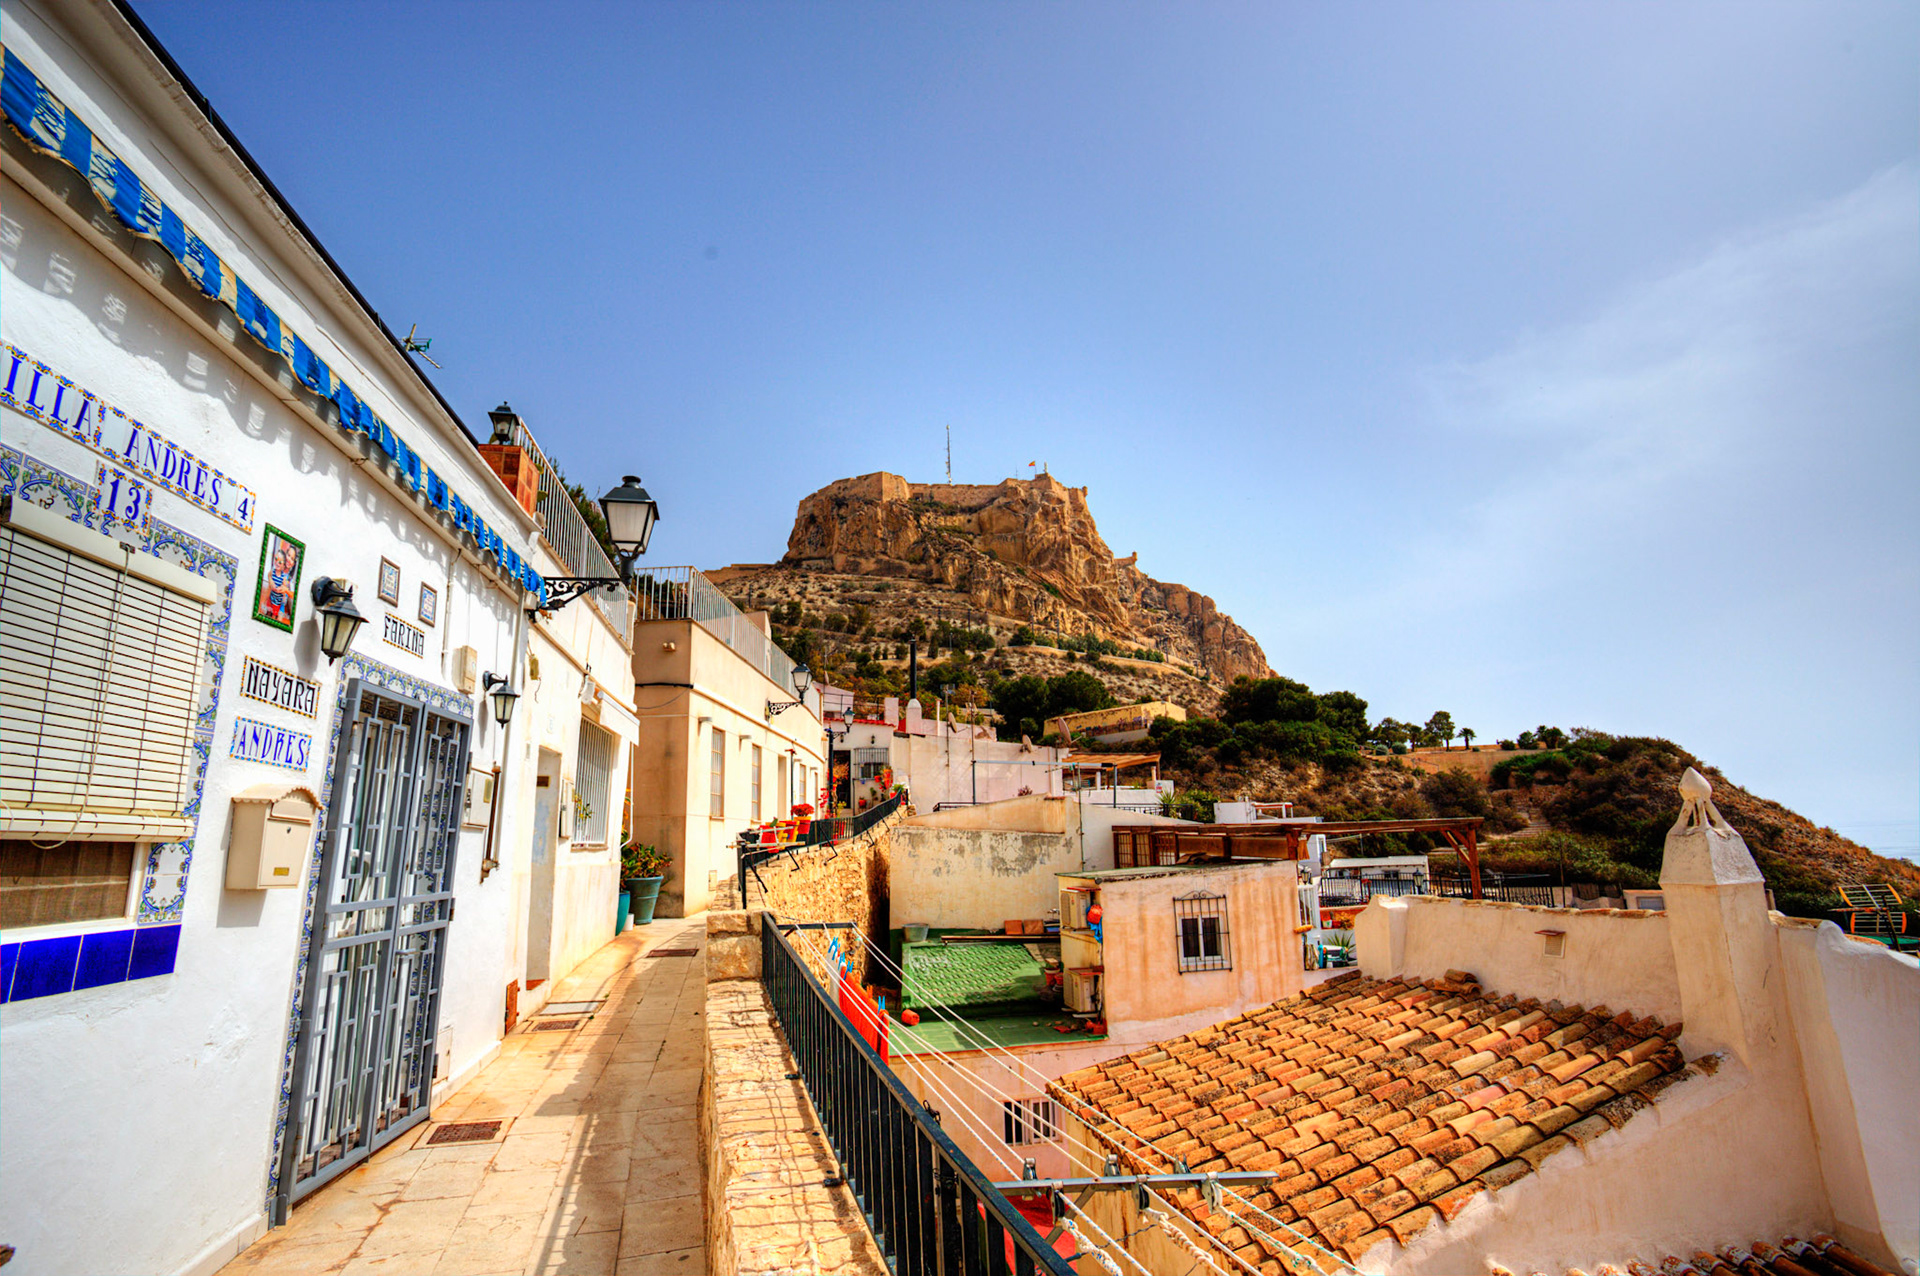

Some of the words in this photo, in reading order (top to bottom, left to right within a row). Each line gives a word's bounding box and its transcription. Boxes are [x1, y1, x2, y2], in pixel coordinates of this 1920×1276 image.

[123, 427, 223, 506] ANDRES
[236, 497, 249, 522] 4
[106, 478, 142, 521] 13
[384, 614, 426, 656] FARINA
[245, 662, 317, 714] NAYARA
[236, 724, 307, 767] ANDRES
